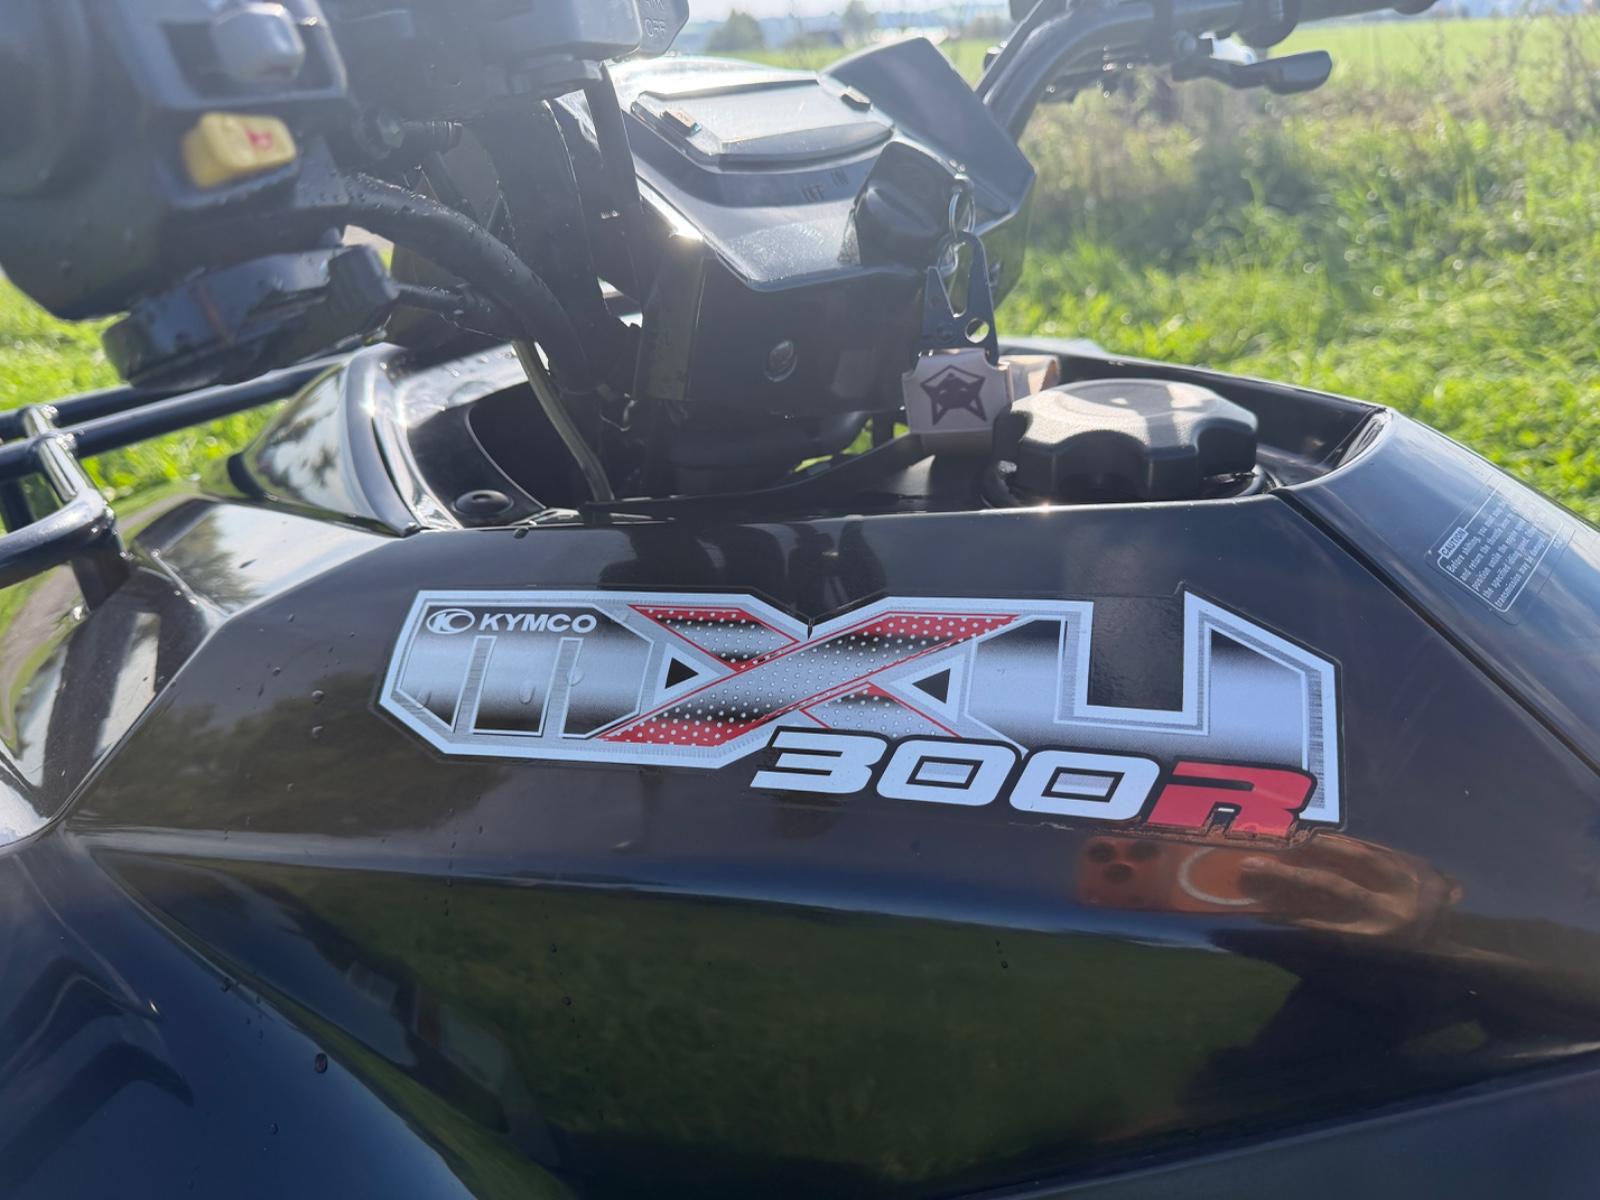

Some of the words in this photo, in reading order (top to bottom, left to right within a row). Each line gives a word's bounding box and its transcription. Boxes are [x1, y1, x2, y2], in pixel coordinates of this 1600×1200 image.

[1445, 552, 1465, 573] Before
[479, 613, 597, 634] KYMCO
[750, 728, 1316, 838] 300R
